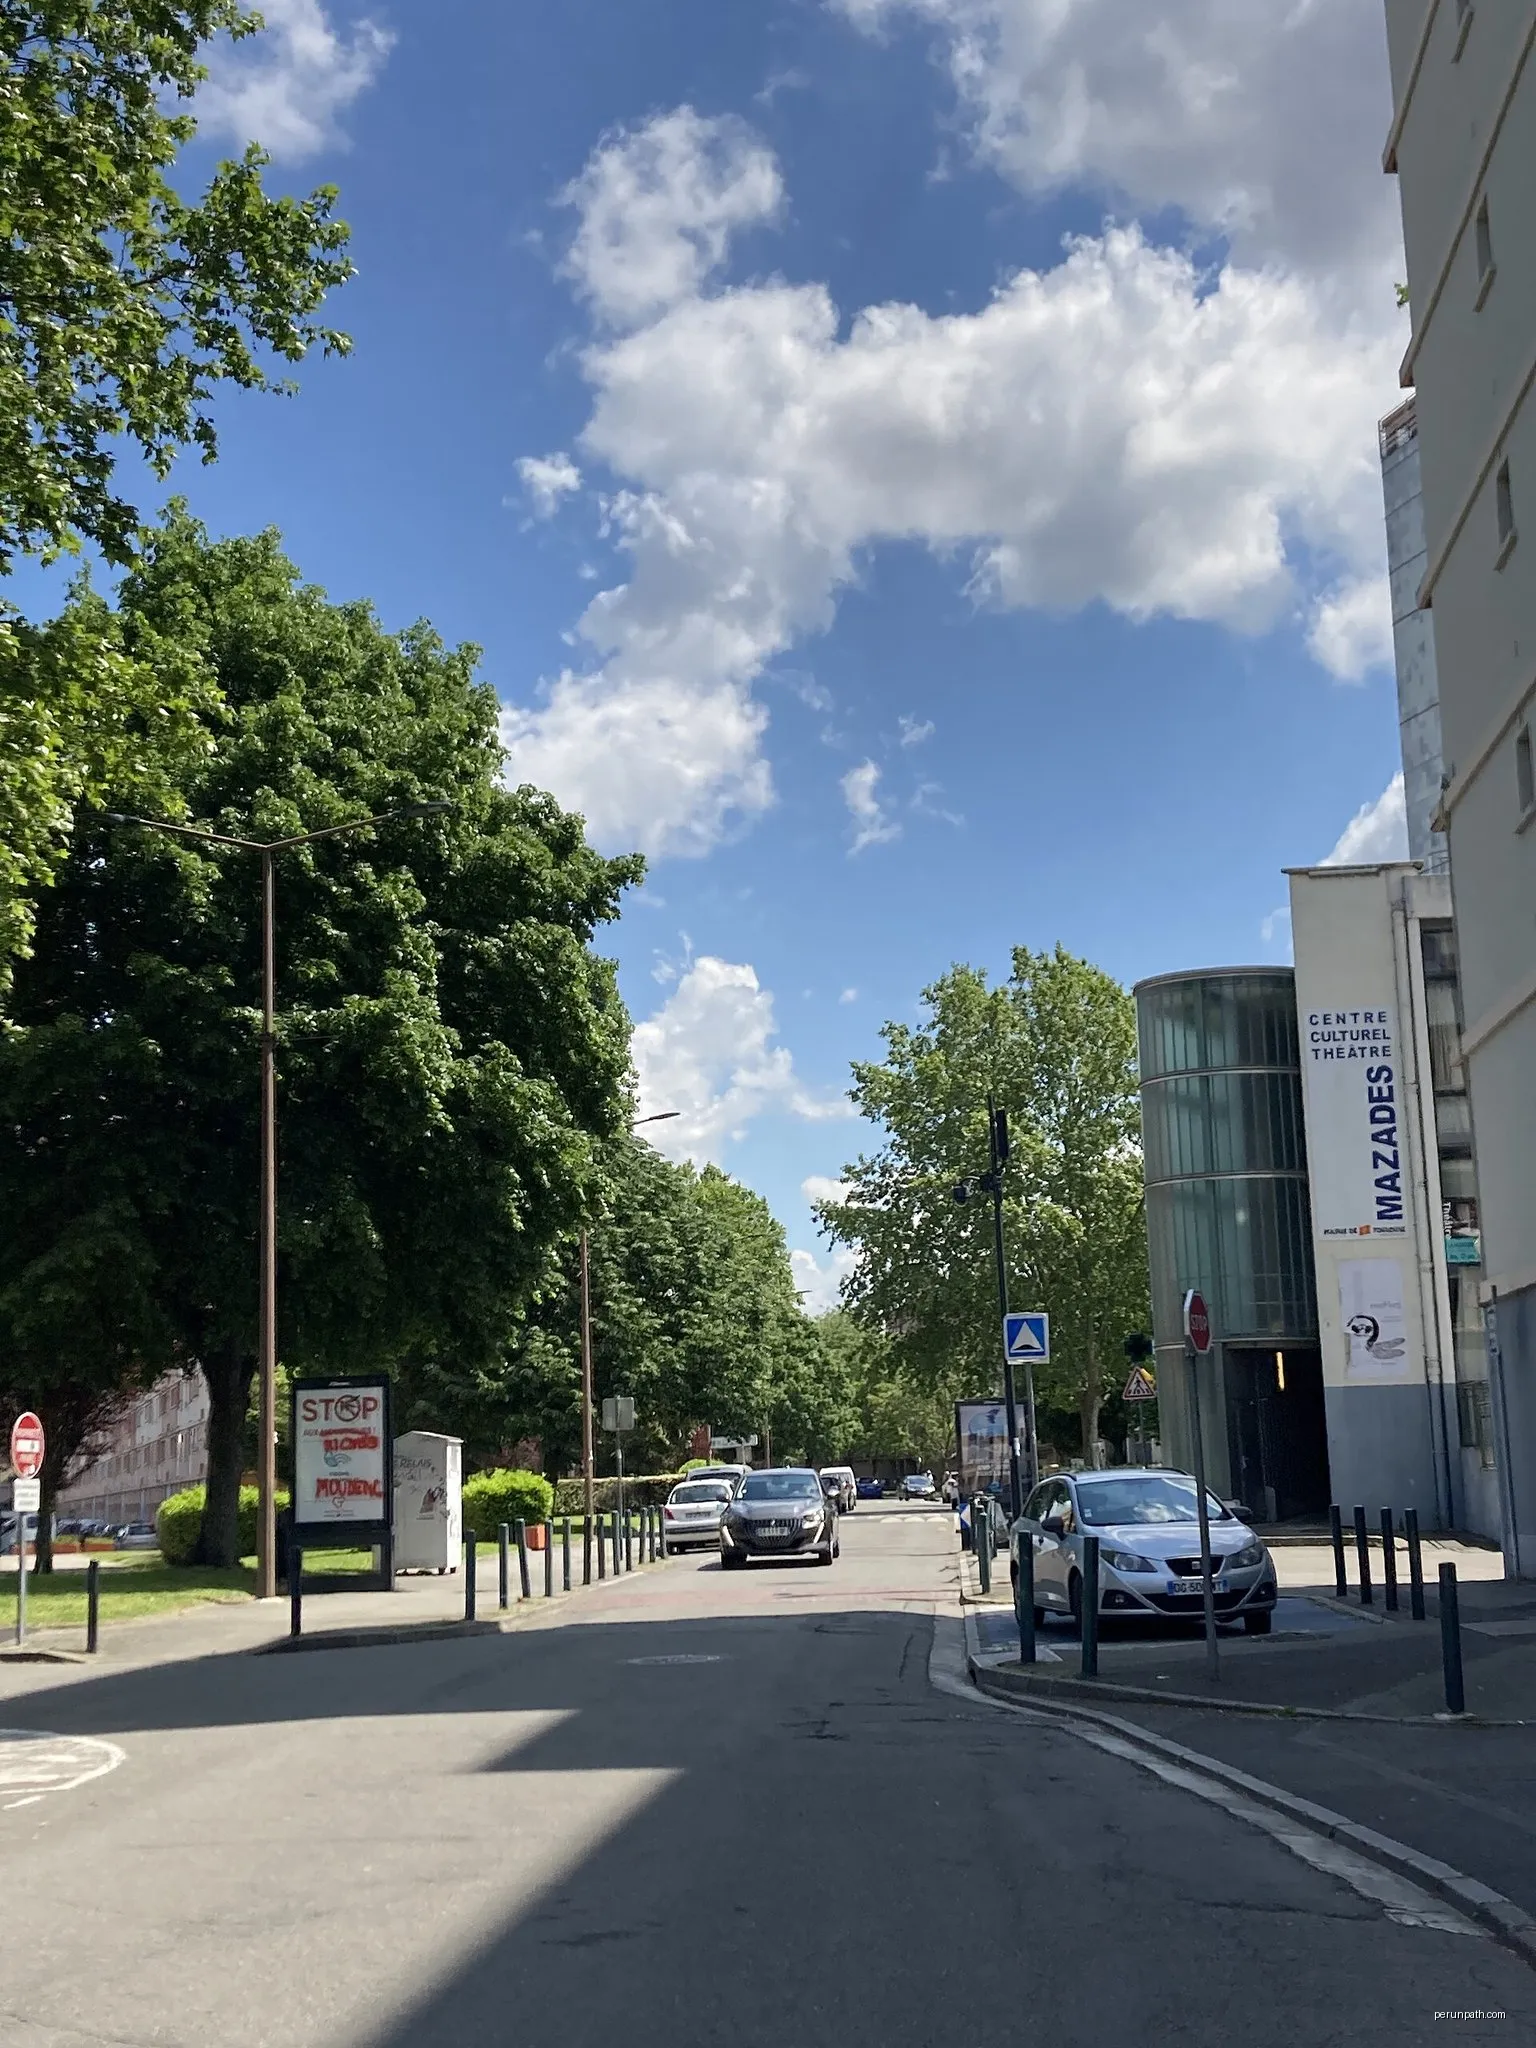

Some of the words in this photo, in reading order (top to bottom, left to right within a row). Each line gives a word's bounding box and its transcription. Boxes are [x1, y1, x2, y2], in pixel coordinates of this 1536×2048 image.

[1309, 1011, 1387, 1026] CENTRE
[1310, 1028, 1391, 1043] CULTUREL
[1311, 1044, 1392, 1060] THÉÂTRE
[1366, 1064, 1403, 1220] MAZADES
[1191, 1314, 1208, 1331] STOP
[302, 1394, 378, 1422] STOP
